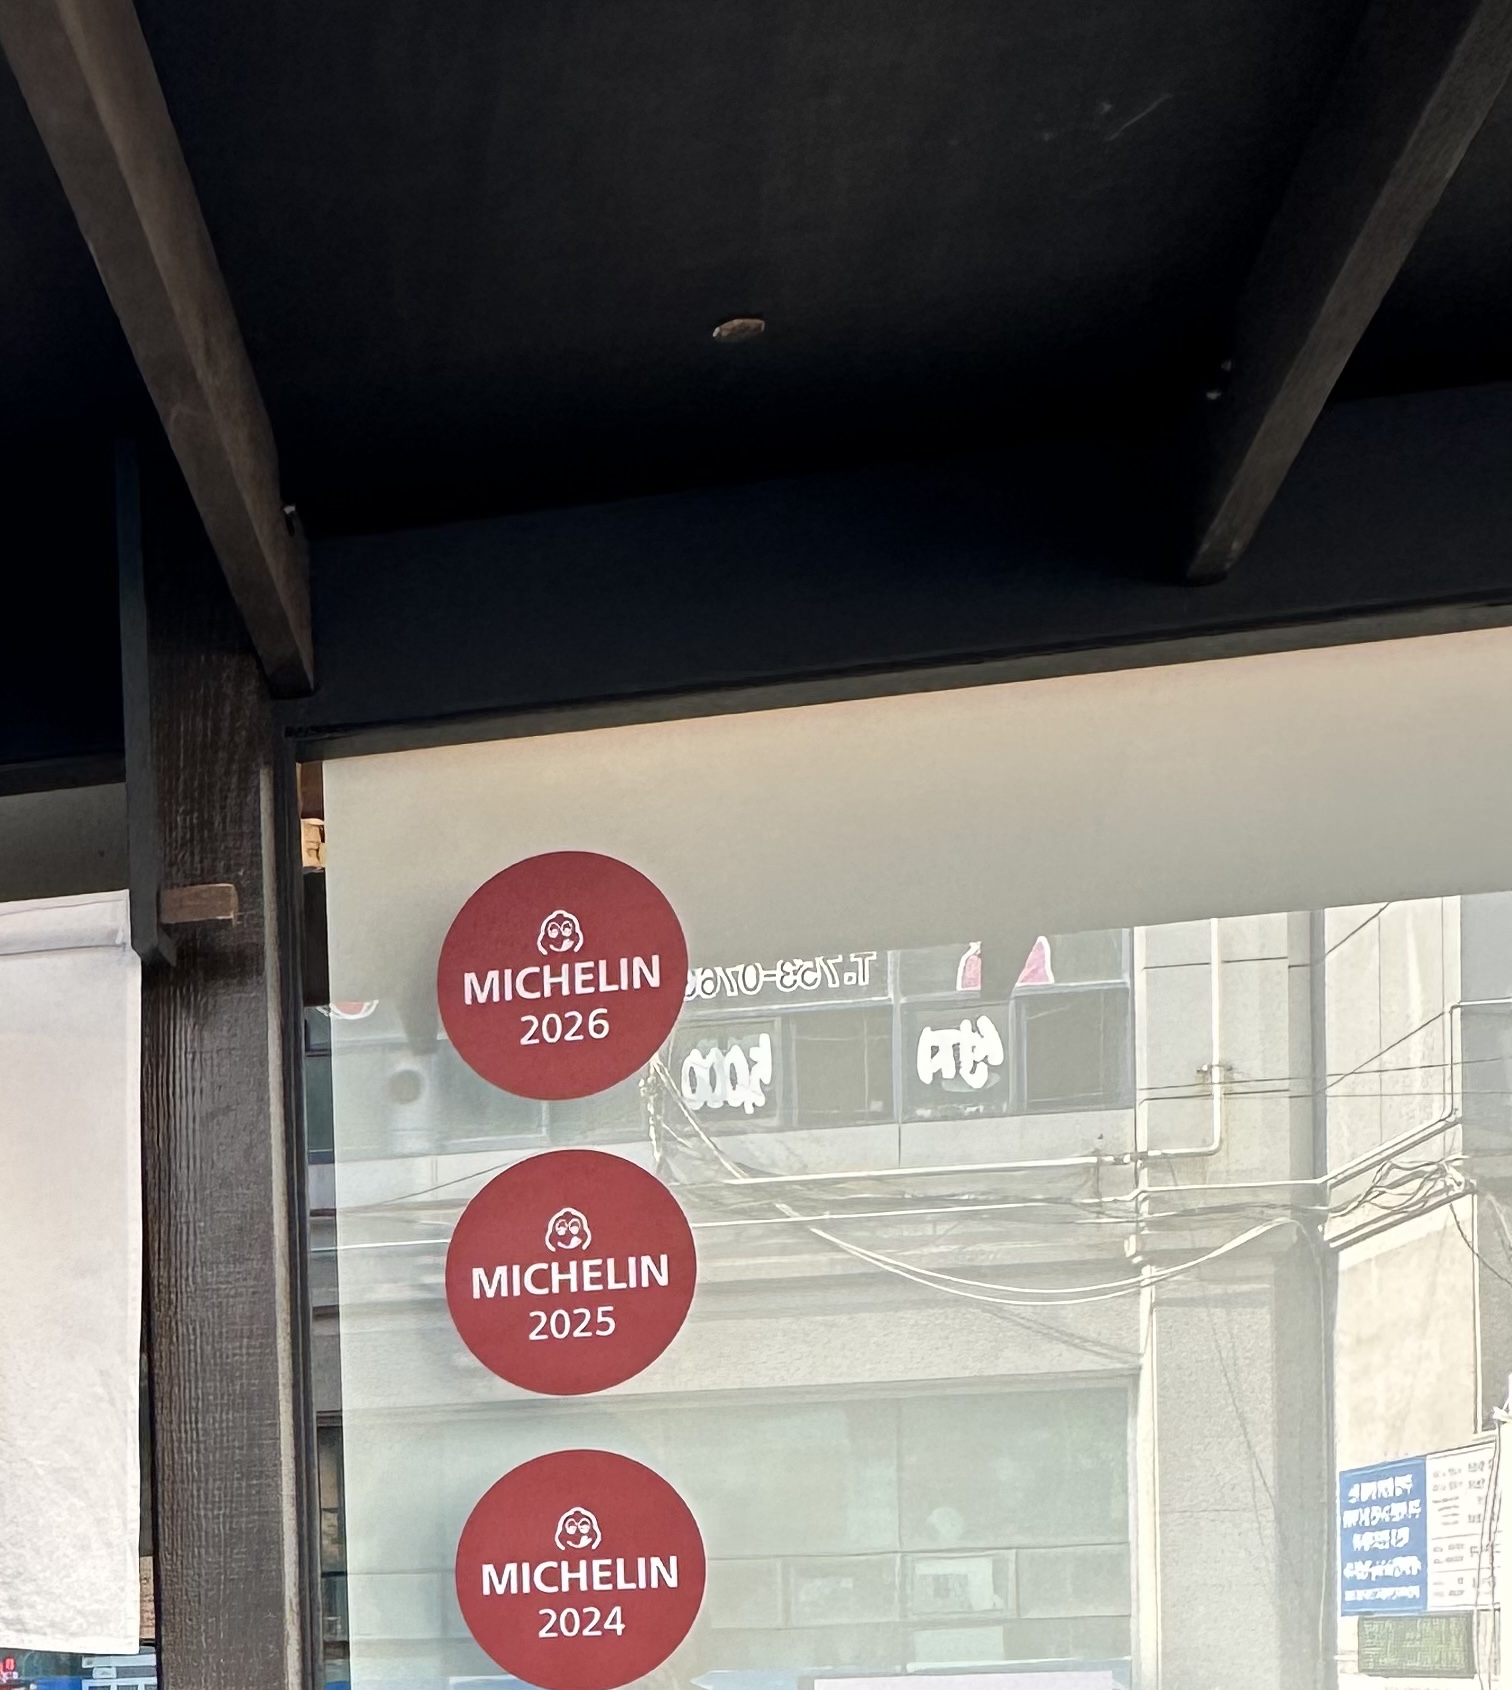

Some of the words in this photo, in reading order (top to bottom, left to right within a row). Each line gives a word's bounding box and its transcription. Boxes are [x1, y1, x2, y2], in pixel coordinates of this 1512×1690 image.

[463, 954, 661, 1006] MICHELIN
[519, 1008, 610, 1046] 2026
[472, 1253, 670, 1300] MICHELIN
[528, 1305, 617, 1341] 2025
[481, 1555, 679, 1596] MICHELIN
[538, 1605, 626, 1639] 2024
